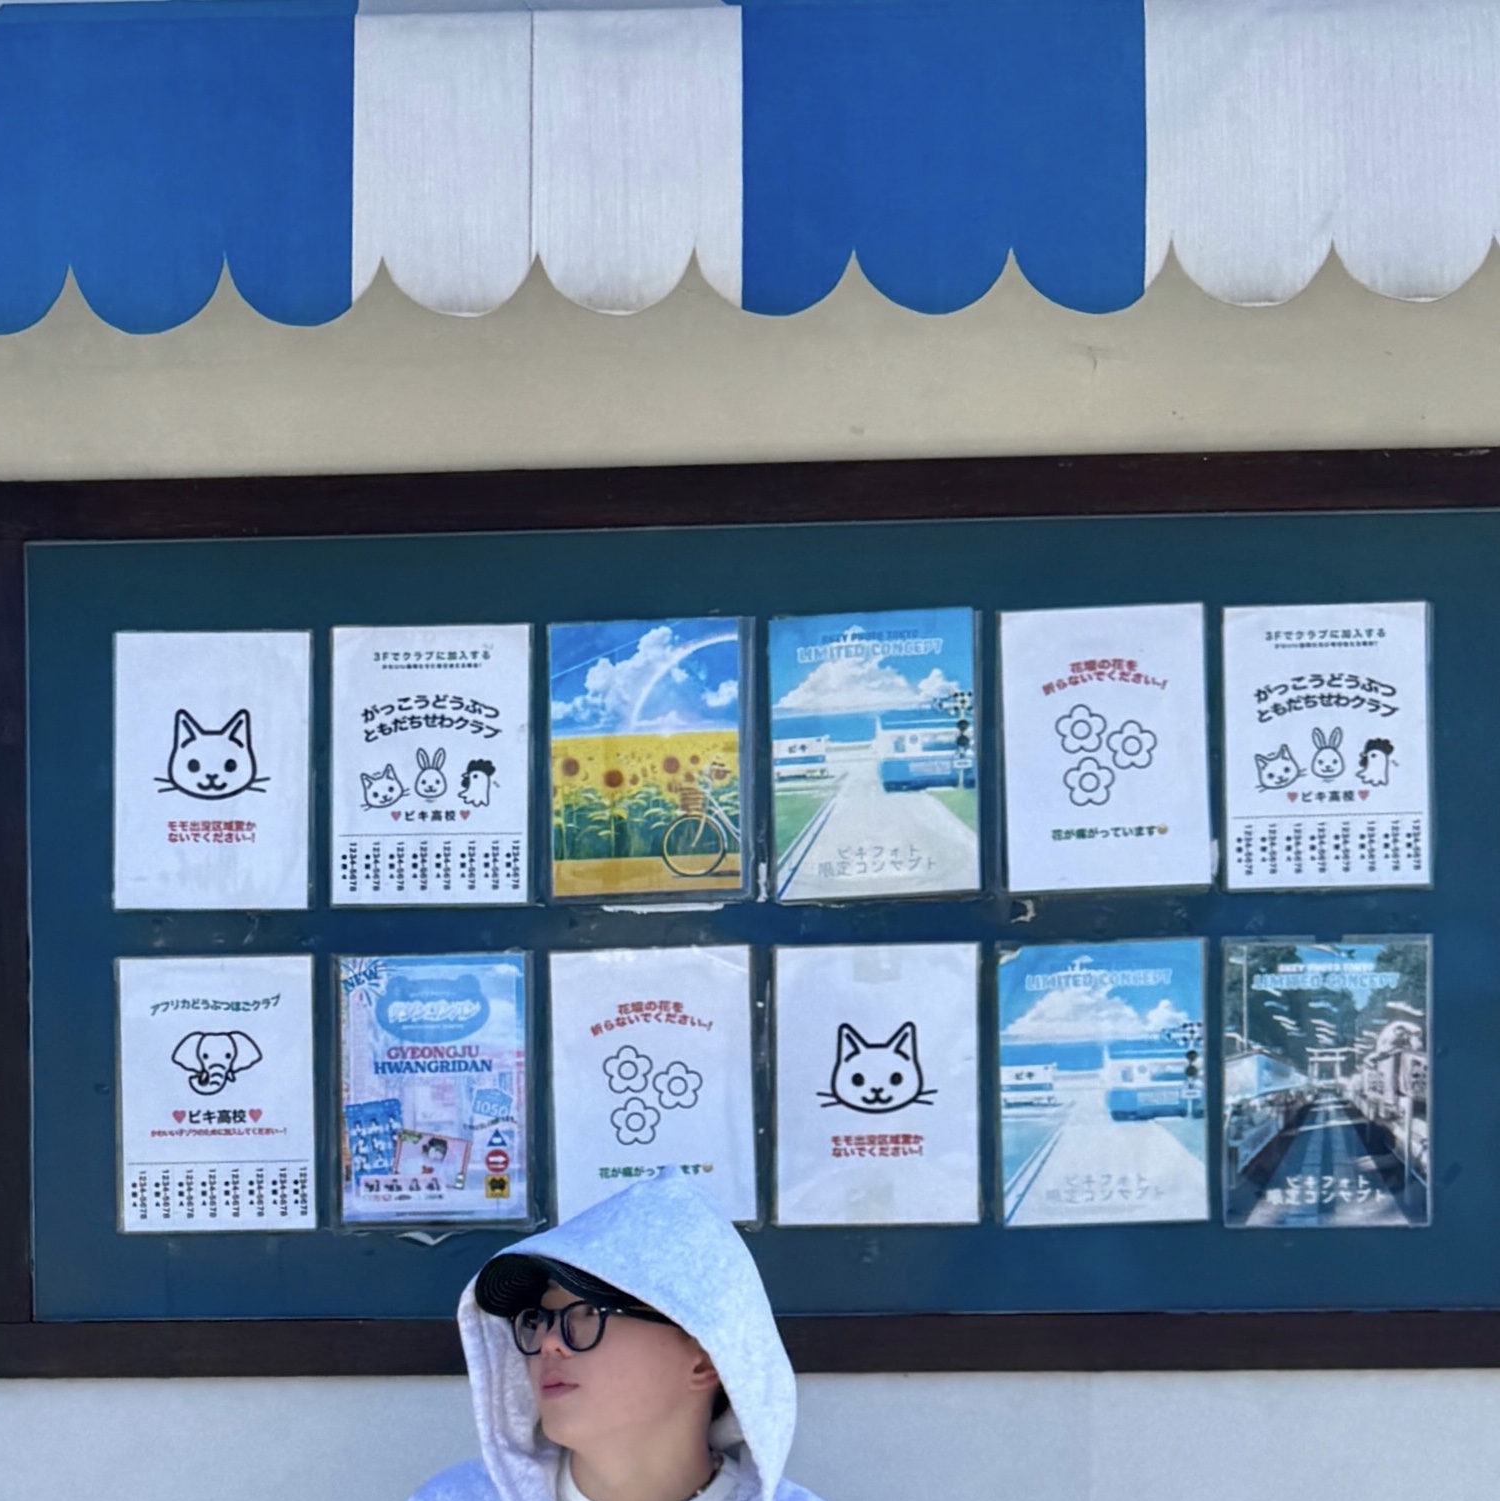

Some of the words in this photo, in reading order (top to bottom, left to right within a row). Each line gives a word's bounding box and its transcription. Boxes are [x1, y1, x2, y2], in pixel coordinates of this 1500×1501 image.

[797, 643, 866, 663] LIMITED
[870, 638, 943, 658] CONCEPT
[1254, 673, 1397, 704] がっこうどうぶつ
[361, 694, 500, 723] がっこうどうぶつ
[1257, 693, 1399, 723] ともだちせわクラブ
[363, 713, 502, 743] ともだちせわクラブ
[343, 965, 381, 993] NEW
[386, 1045, 481, 1060] GYEONGJU
[373, 1059, 493, 1075] HWANGRIDAN
[188, 1108, 247, 1125] ビキ高校
